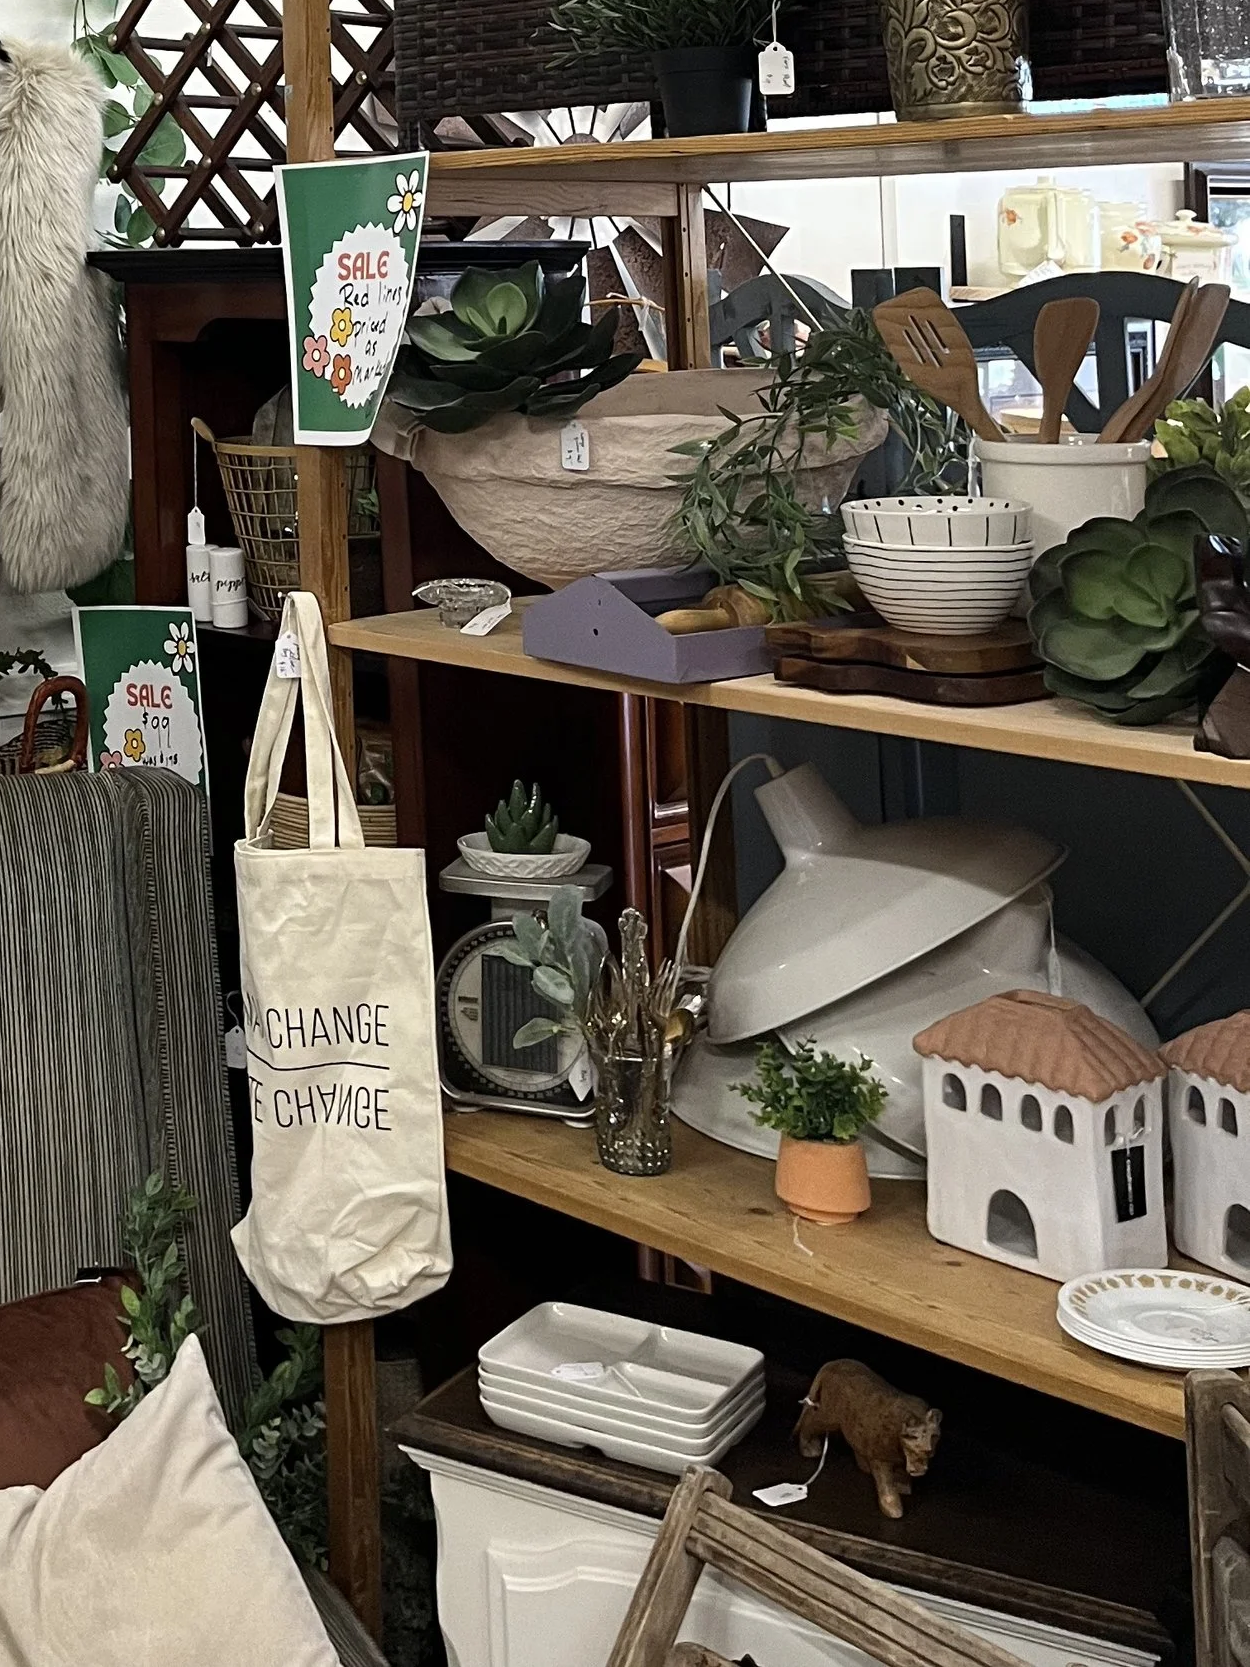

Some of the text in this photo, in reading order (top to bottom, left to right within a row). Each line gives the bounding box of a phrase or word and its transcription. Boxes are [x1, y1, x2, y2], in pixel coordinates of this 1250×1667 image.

[337, 250, 390, 281] SALE
[339, 283, 403, 308] Red lines
[352, 313, 387, 348] priced
[364, 338, 376, 357] as
[126, 683, 173, 710] SALE
[266, 1002, 390, 1049] CHANGE
[273, 1083, 392, 1132] CHANGE
